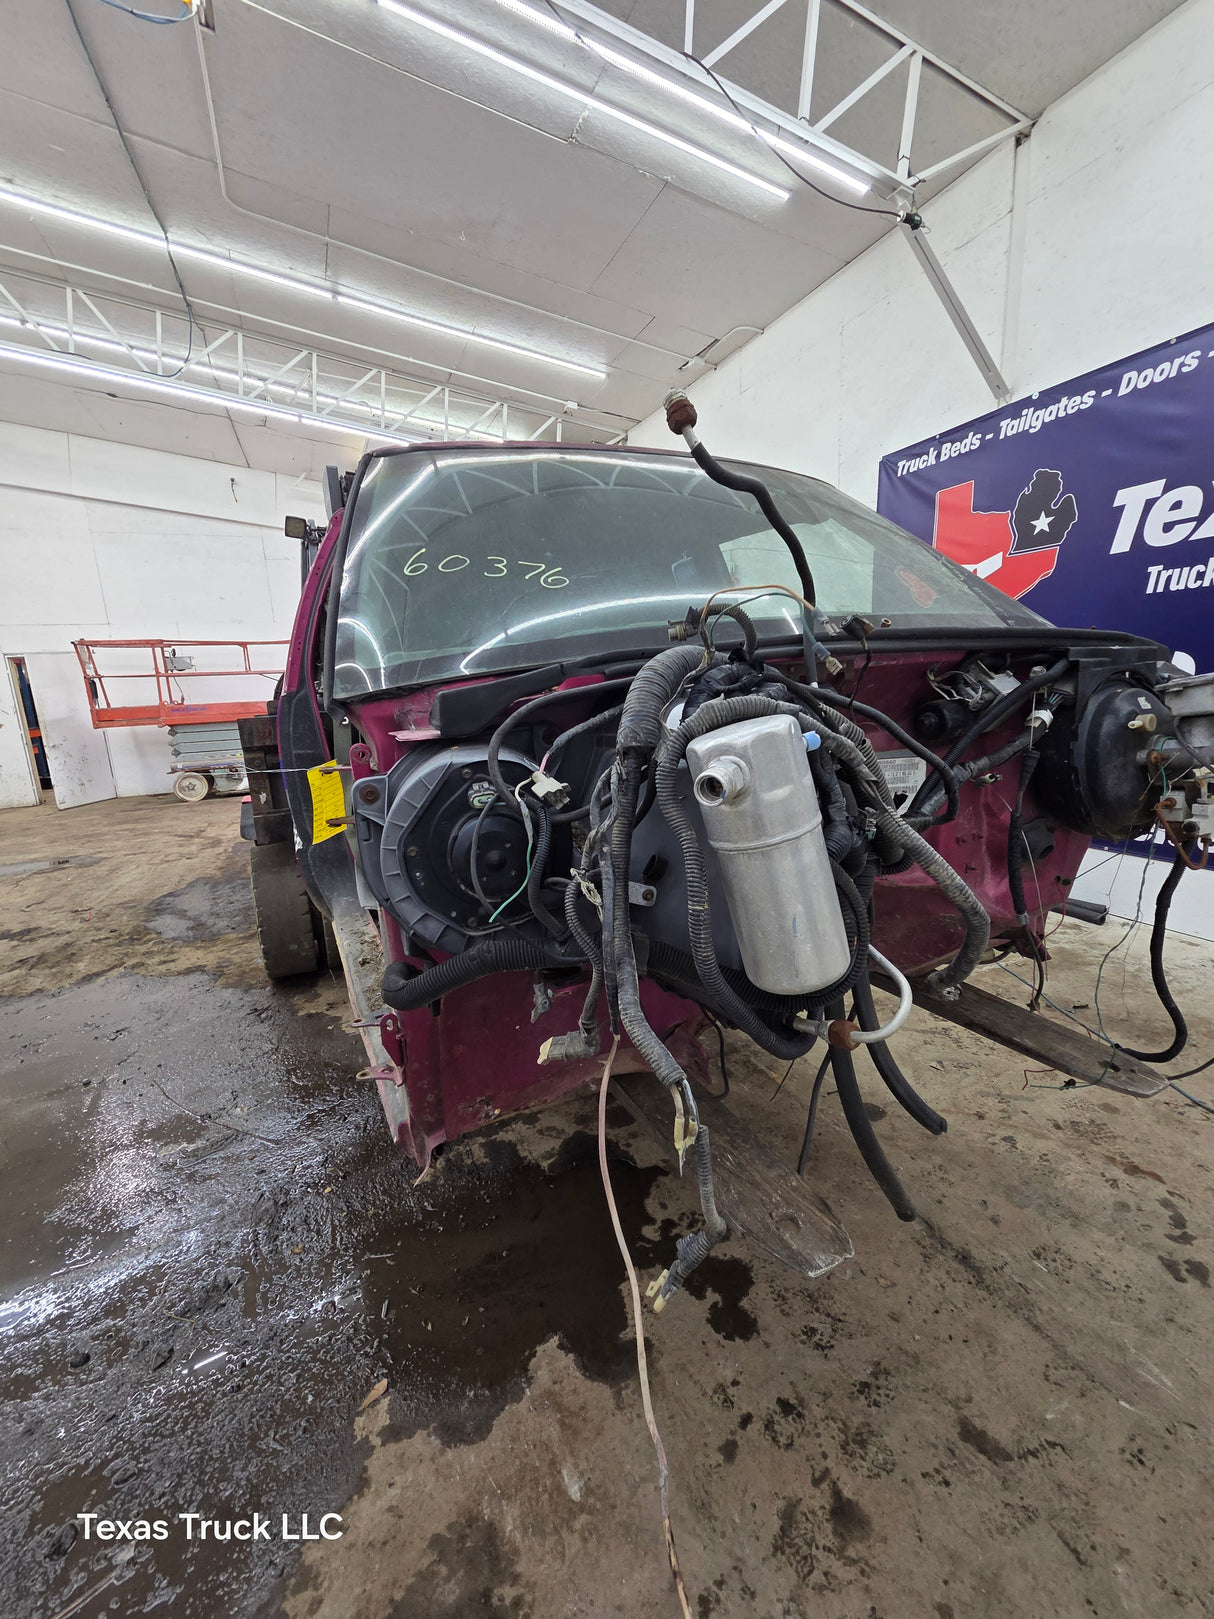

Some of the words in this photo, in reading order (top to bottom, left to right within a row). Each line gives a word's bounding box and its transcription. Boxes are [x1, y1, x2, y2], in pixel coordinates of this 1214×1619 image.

[897, 447, 938, 477] Truck
[940, 432, 982, 462] Beds
[999, 390, 1096, 440] Tailgates
[1117, 350, 1202, 397] Doors
[403, 548, 570, 589] 60376
